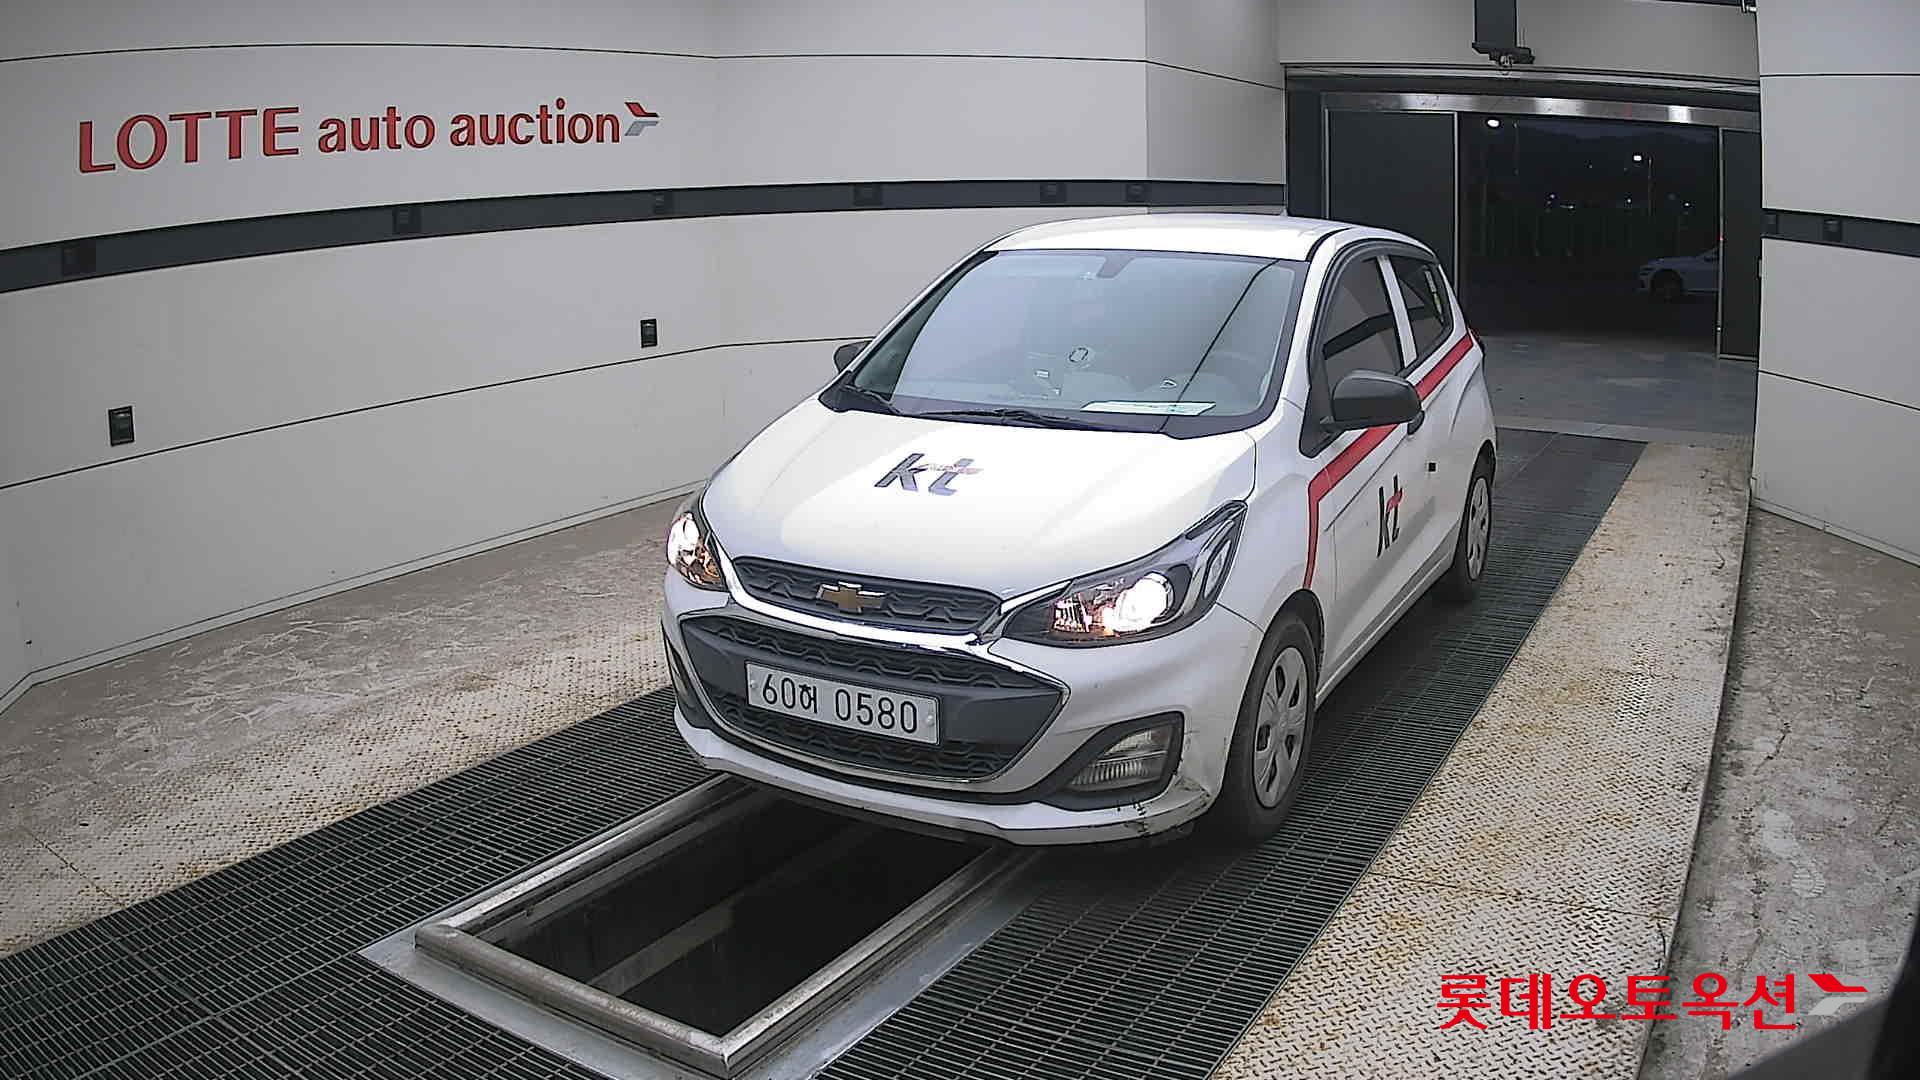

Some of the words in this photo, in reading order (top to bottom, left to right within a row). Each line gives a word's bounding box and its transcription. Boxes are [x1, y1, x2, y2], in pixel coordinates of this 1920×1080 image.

[79, 106, 300, 173] LOTTE
[317, 105, 436, 153] auto
[450, 97, 620, 147] auction
[873, 452, 981, 496] kt
[1376, 474, 1403, 558] kt
[762, 673, 818, 714] 60허
[835, 688, 918, 734] 0580
